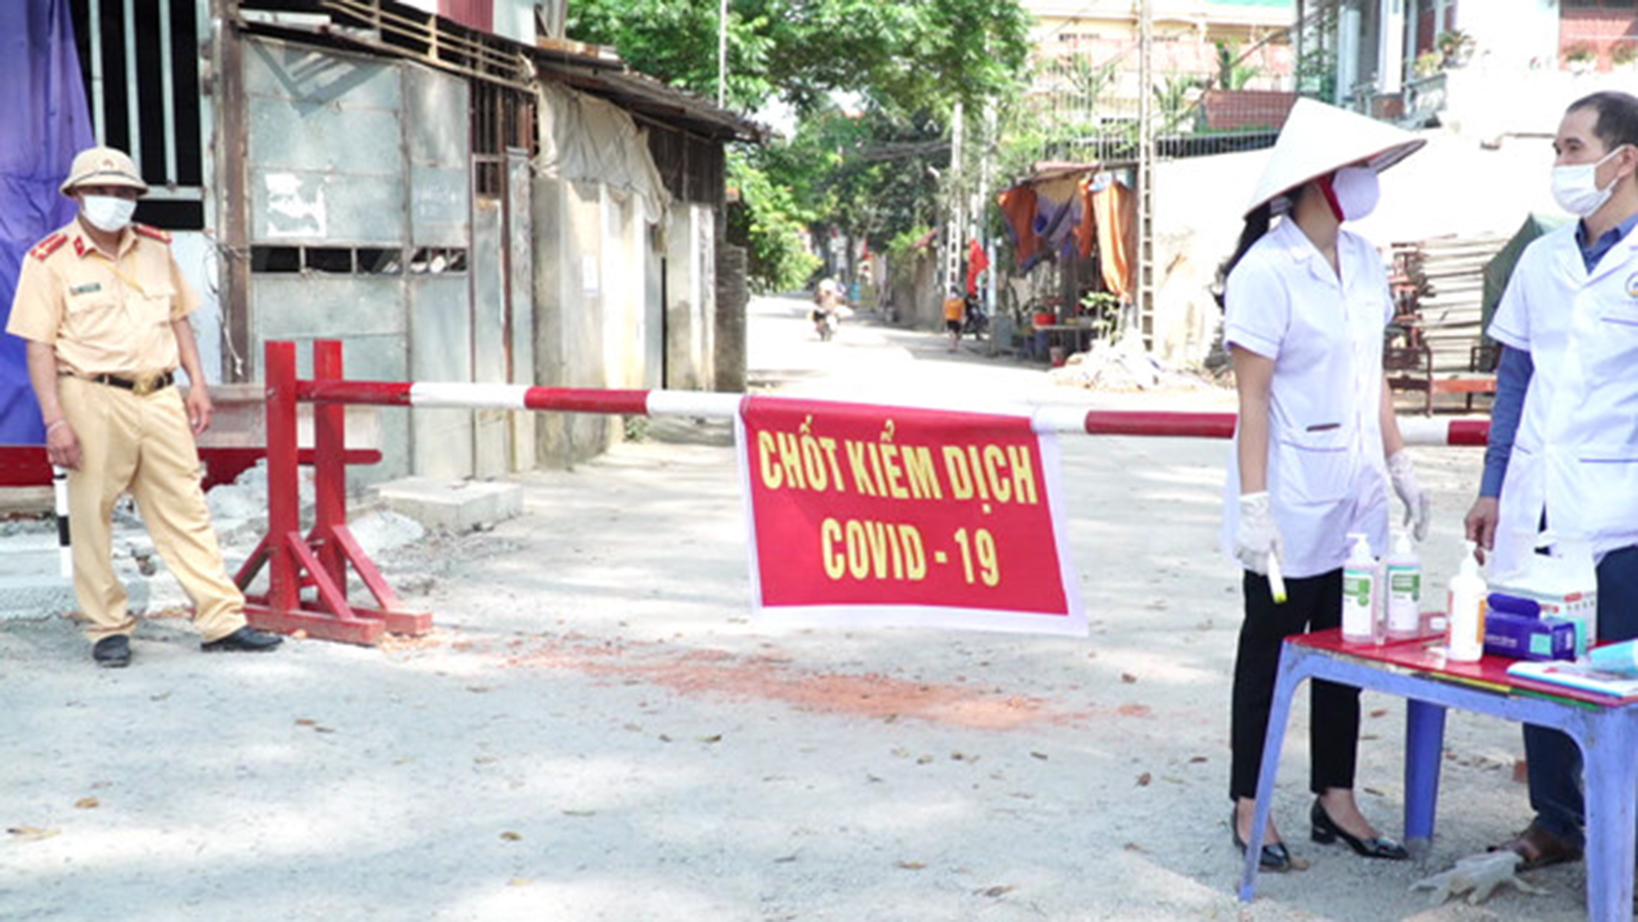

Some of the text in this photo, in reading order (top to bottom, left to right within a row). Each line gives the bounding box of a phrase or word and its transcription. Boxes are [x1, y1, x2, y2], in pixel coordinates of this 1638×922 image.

[757, 415, 1038, 515] CHỐT KIỂM DỊCH
[821, 517, 927, 581] COVID
[953, 527, 1000, 587] 19
